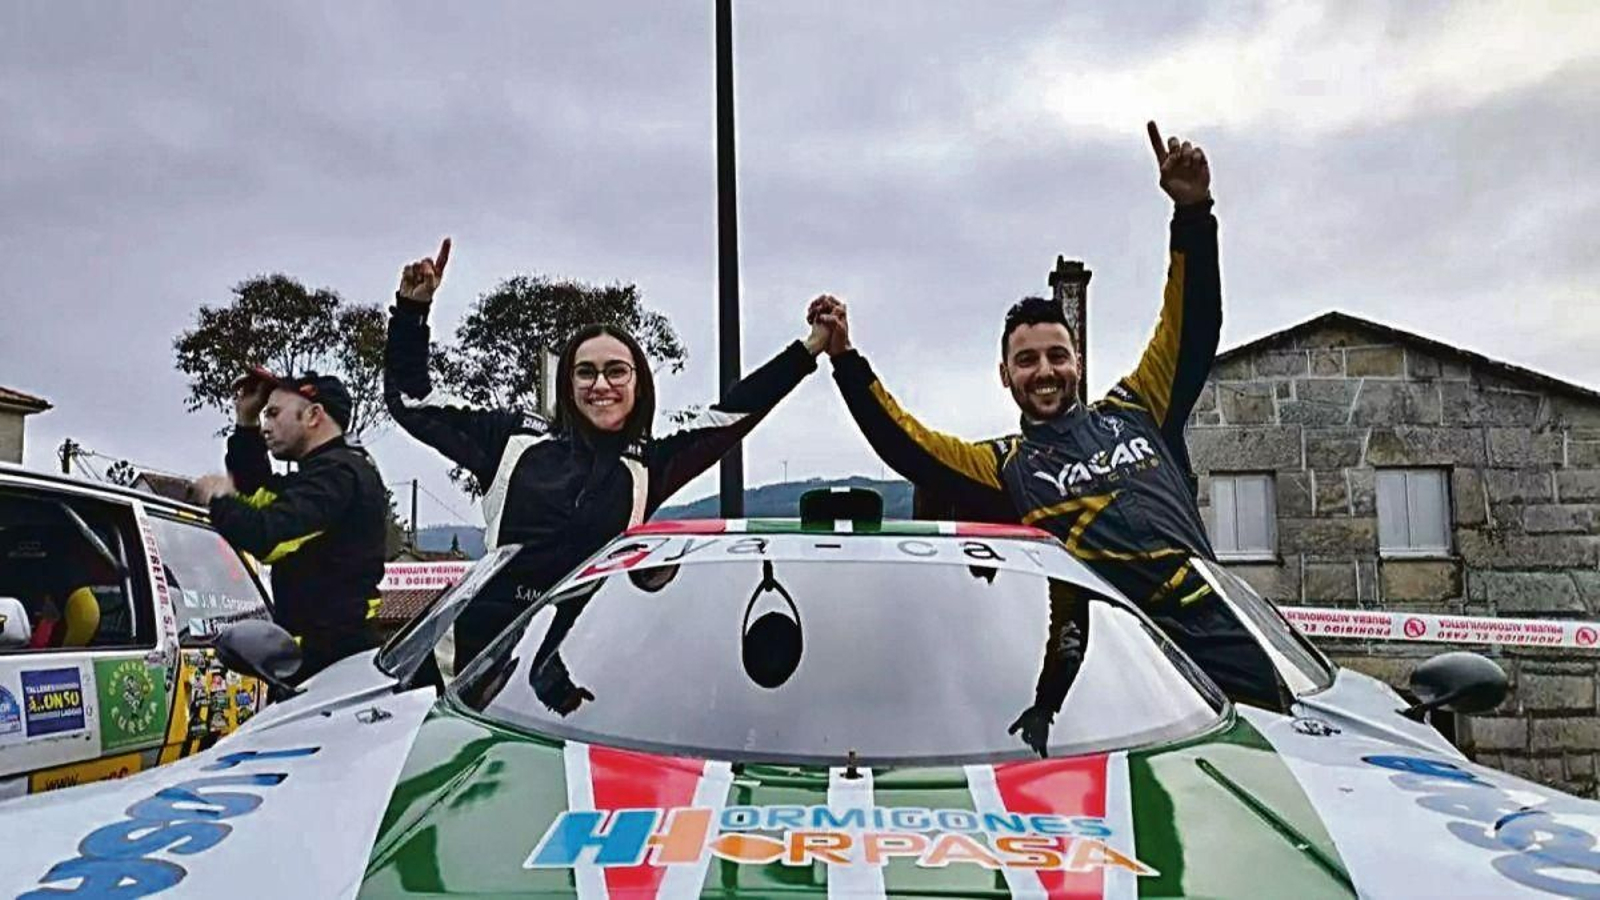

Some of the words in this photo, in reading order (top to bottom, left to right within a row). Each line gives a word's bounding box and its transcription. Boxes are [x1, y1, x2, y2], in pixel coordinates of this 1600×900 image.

[1033, 436, 1155, 497] YACAR
[1352, 613, 1392, 626] PRUEBA
[1303, 623, 1317, 632] EL
[1323, 624, 1392, 636] PROHIBIDO
[1523, 622, 1564, 634] PRUEBA
[1437, 630, 1469, 640] PASO
[1476, 632, 1489, 640] EL
[1495, 633, 1563, 643] PROHIBIDO
[28, 690, 80, 713] AONSO
